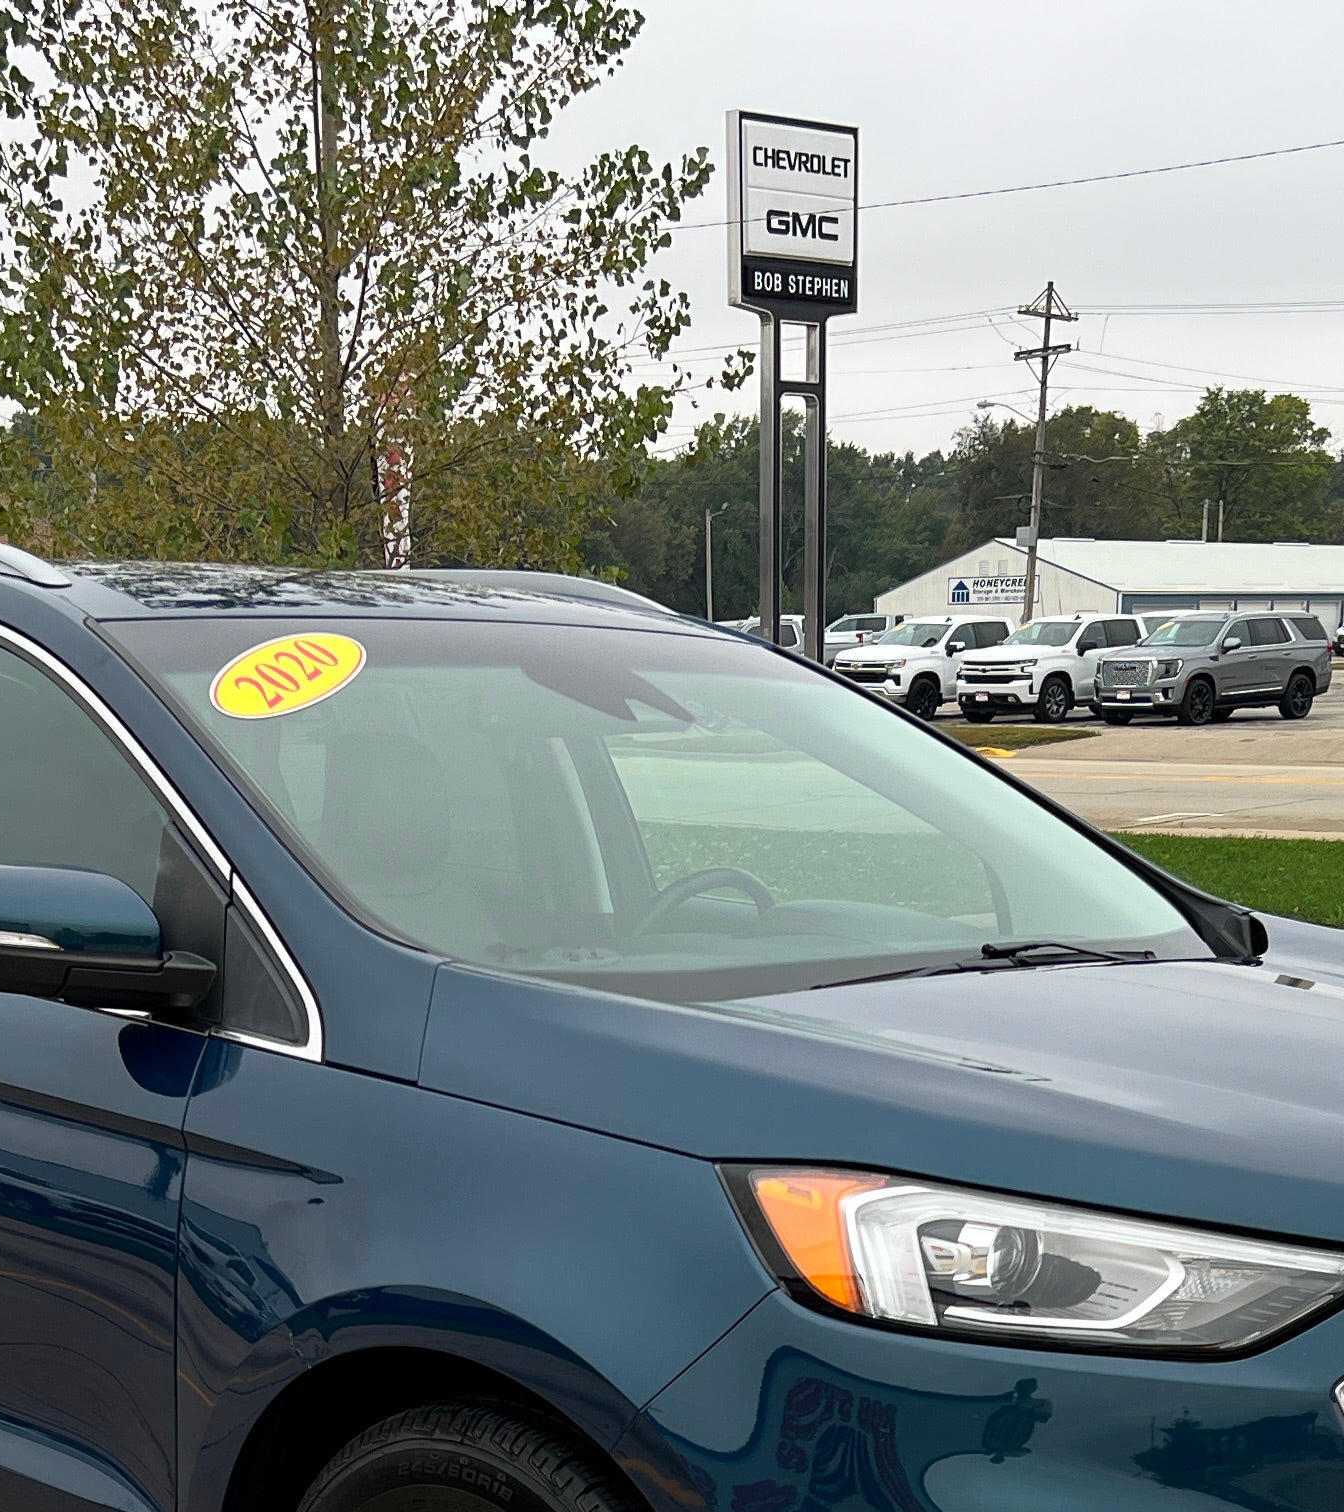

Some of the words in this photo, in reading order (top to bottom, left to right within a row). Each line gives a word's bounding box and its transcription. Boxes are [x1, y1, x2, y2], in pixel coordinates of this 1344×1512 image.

[752, 145, 851, 178] CHEVROLET
[766, 209, 839, 241] GMC
[754, 271, 782, 292] BOB
[788, 274, 849, 298] STEPHEN
[972, 578, 1027, 588] HONEYCRE
[234, 640, 339, 709] 2020
